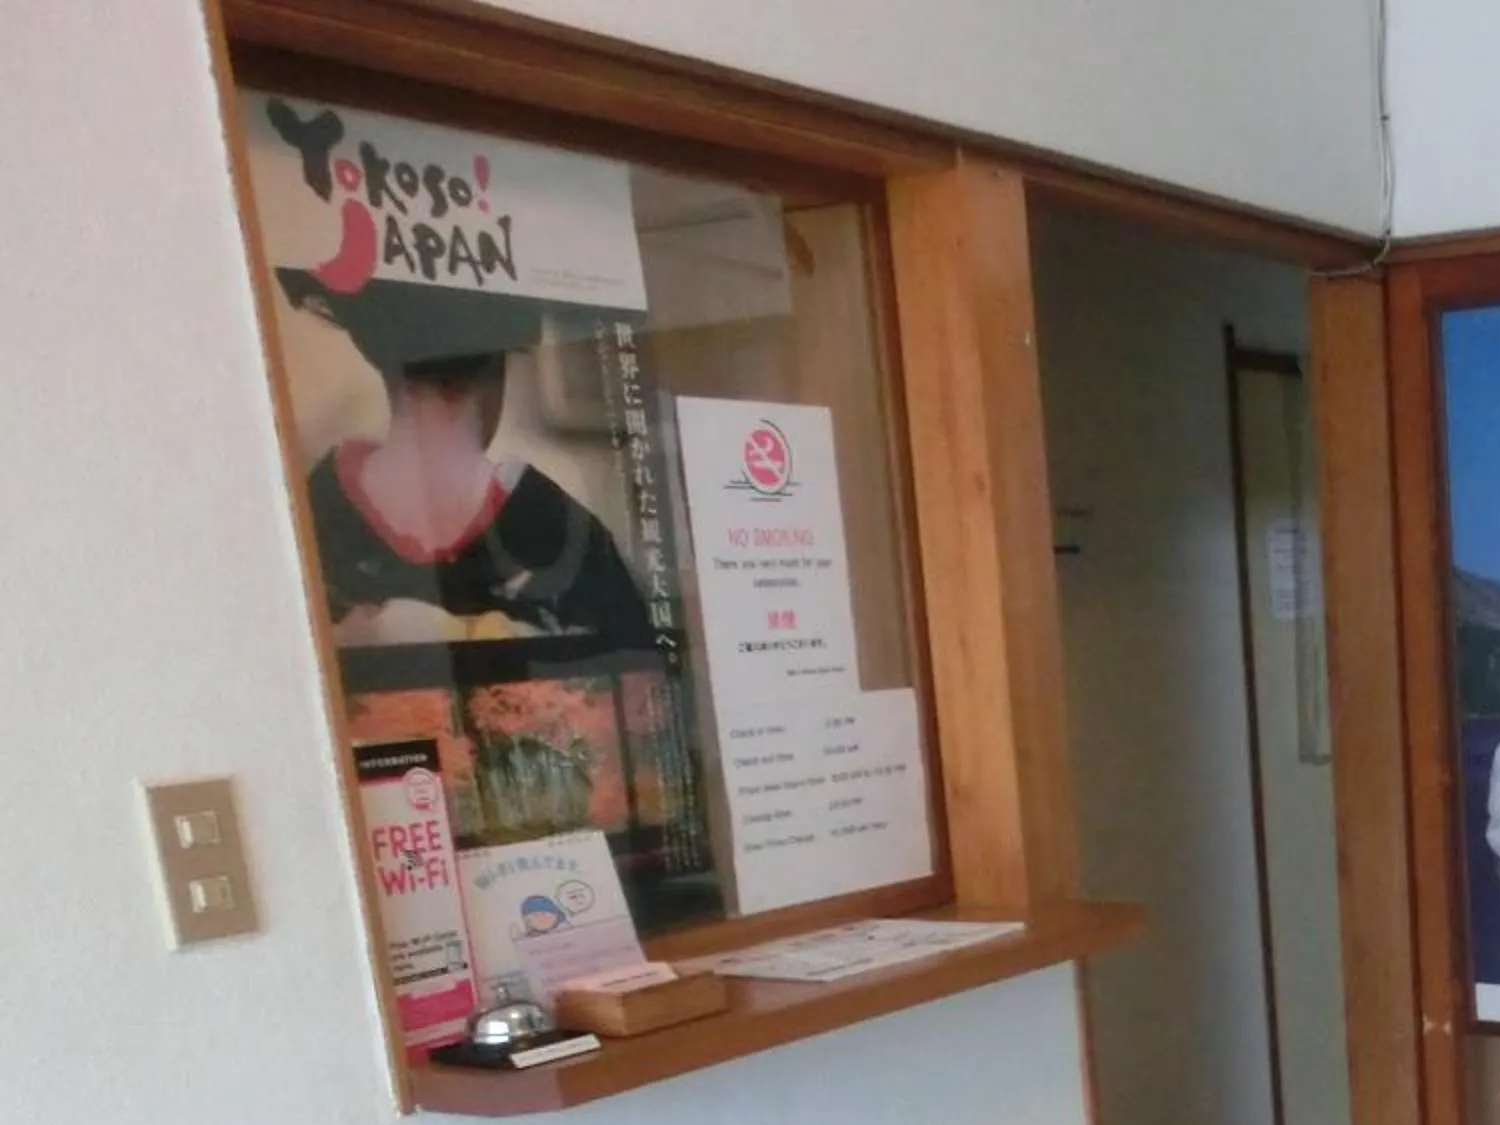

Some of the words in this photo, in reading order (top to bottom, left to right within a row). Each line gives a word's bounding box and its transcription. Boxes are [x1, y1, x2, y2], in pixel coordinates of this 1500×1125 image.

[314, 198, 519, 296] JAPAN
[727, 528, 749, 548] NO
[371, 819, 444, 862] FREE
[375, 856, 449, 897] Wi-Fi
